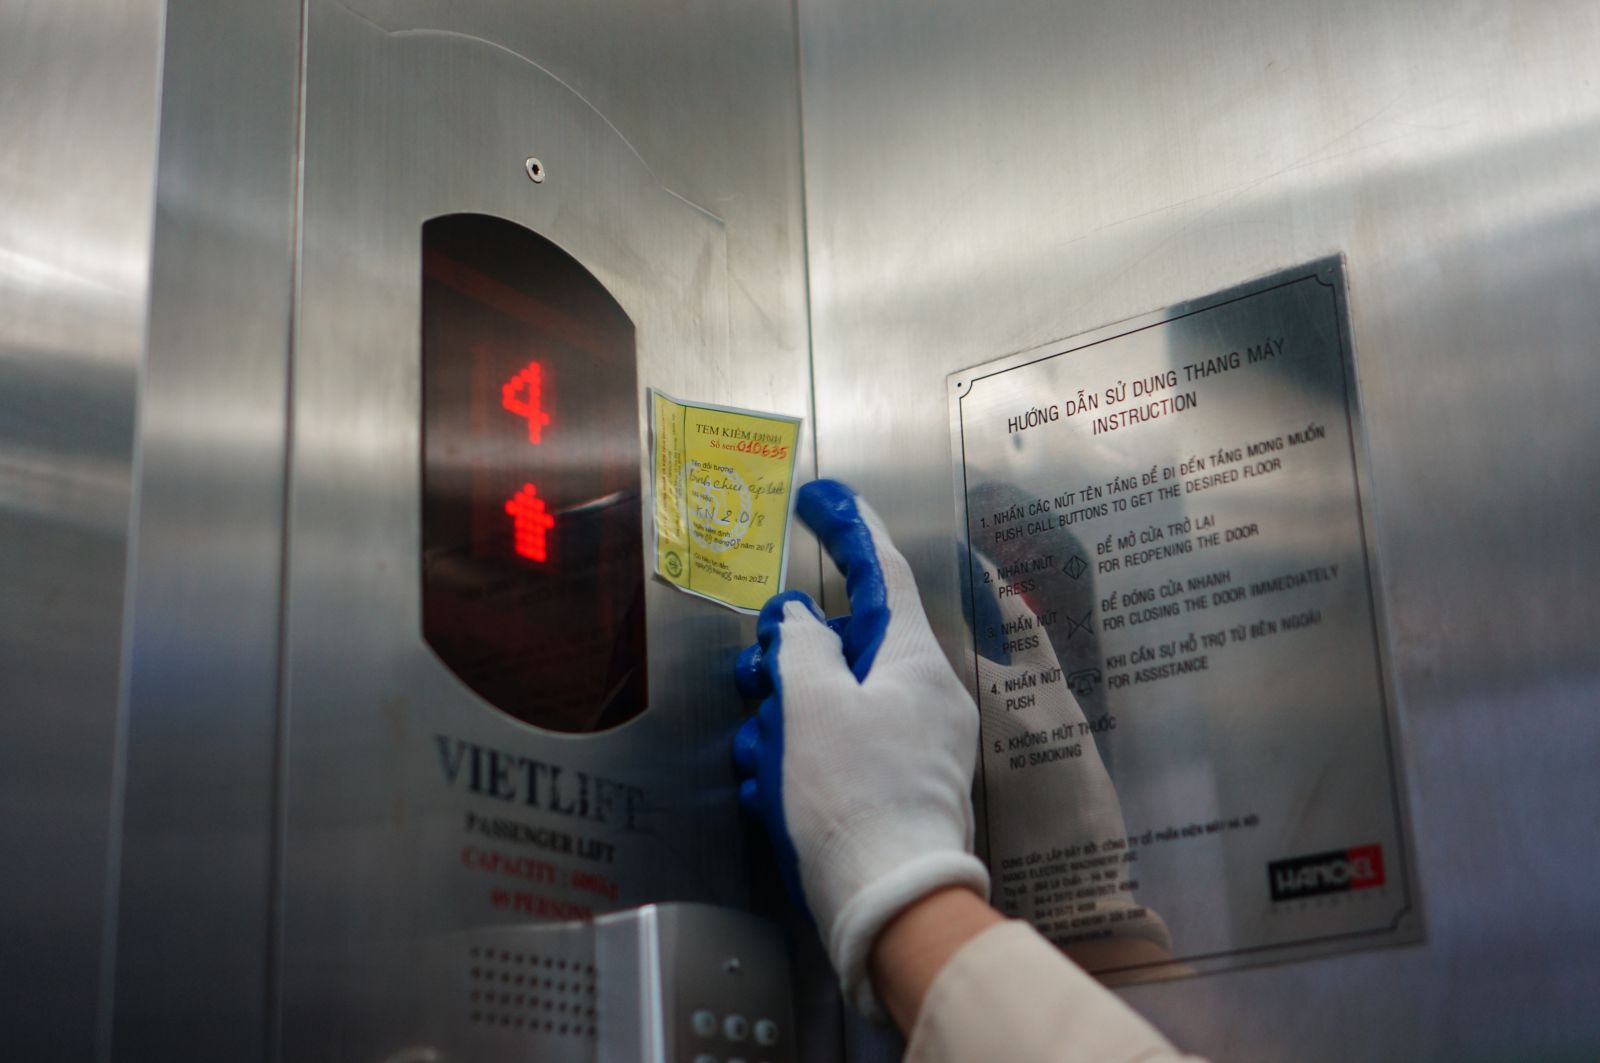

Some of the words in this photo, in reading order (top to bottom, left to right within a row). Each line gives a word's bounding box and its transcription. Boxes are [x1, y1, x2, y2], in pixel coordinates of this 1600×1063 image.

[502, 361, 550, 442] 4
[1008, 401, 1059, 433] HƯỚNG
[1066, 390, 1098, 417] DẪN
[1105, 382, 1127, 405] SỬ
[1133, 371, 1177, 397] DỤNG
[1184, 352, 1240, 381] THANG
[1247, 338, 1285, 363] MÁY
[696, 423, 719, 435] TEM
[1093, 391, 1198, 435] INSTRUCTION
[980, 516, 990, 530] 1.
[994, 502, 1025, 525] NHẤN
[1029, 497, 1050, 519] CÁC
[1054, 491, 1075, 511] NÚT
[1080, 484, 1102, 505] TÊN
[1142, 465, 1158, 486] ĐỂ
[1163, 464, 1176, 480] ĐI
[1180, 452, 1205, 476] ĐẾN
[1247, 436, 1284, 458] MONG
[995, 523, 1024, 543] PUSH
[1027, 517, 1055, 537] CALL
[1058, 502, 1108, 529] BUTTONS
[1112, 497, 1127, 513] TO
[1131, 490, 1153, 509] GET
[1157, 484, 1182, 503] THE
[1185, 469, 1239, 494] DESIRED
[1243, 457, 1282, 482] FLOOR
[1097, 534, 1113, 555] ĐỂ
[1118, 531, 1136, 549] MỞ
[1140, 526, 1164, 545] CỬA
[1168, 516, 1192, 537] TRỞ
[1098, 558, 1120, 574] FOR
[1124, 540, 1193, 568] REOPENING
[1197, 533, 1220, 550] THE
[1225, 523, 1259, 543] DOOR
[1032, 555, 1056, 571] NÚT
[999, 579, 1036, 599] PRESS
[1101, 591, 1118, 612] ĐỂ
[1122, 586, 1156, 607] ĐÓNG
[1159, 579, 1184, 598] CỬA
[1188, 570, 1232, 592] NHANH
[1103, 615, 1126, 632] FOR
[1129, 602, 1180, 626] CLOSING
[1184, 595, 1209, 613] THE
[1212, 586, 1247, 607] DOOR
[1251, 564, 1340, 598] IMMEDIATELY
[1003, 635, 1040, 654] PRESS
[1106, 654, 1127, 671] KHI
[1108, 673, 1131, 690] FOR
[1134, 655, 1210, 685] ASSISTANCE
[1006, 695, 1036, 712] PUSH
[1008, 729, 1048, 751] KHÔNG
[1052, 722, 1075, 741] HÚT
[1009, 756, 1026, 771] NO
[1030, 743, 1083, 767] SMOKING
[433, 734, 646, 832] VIETLIFT
[465, 811, 573, 856] PASSENGER
